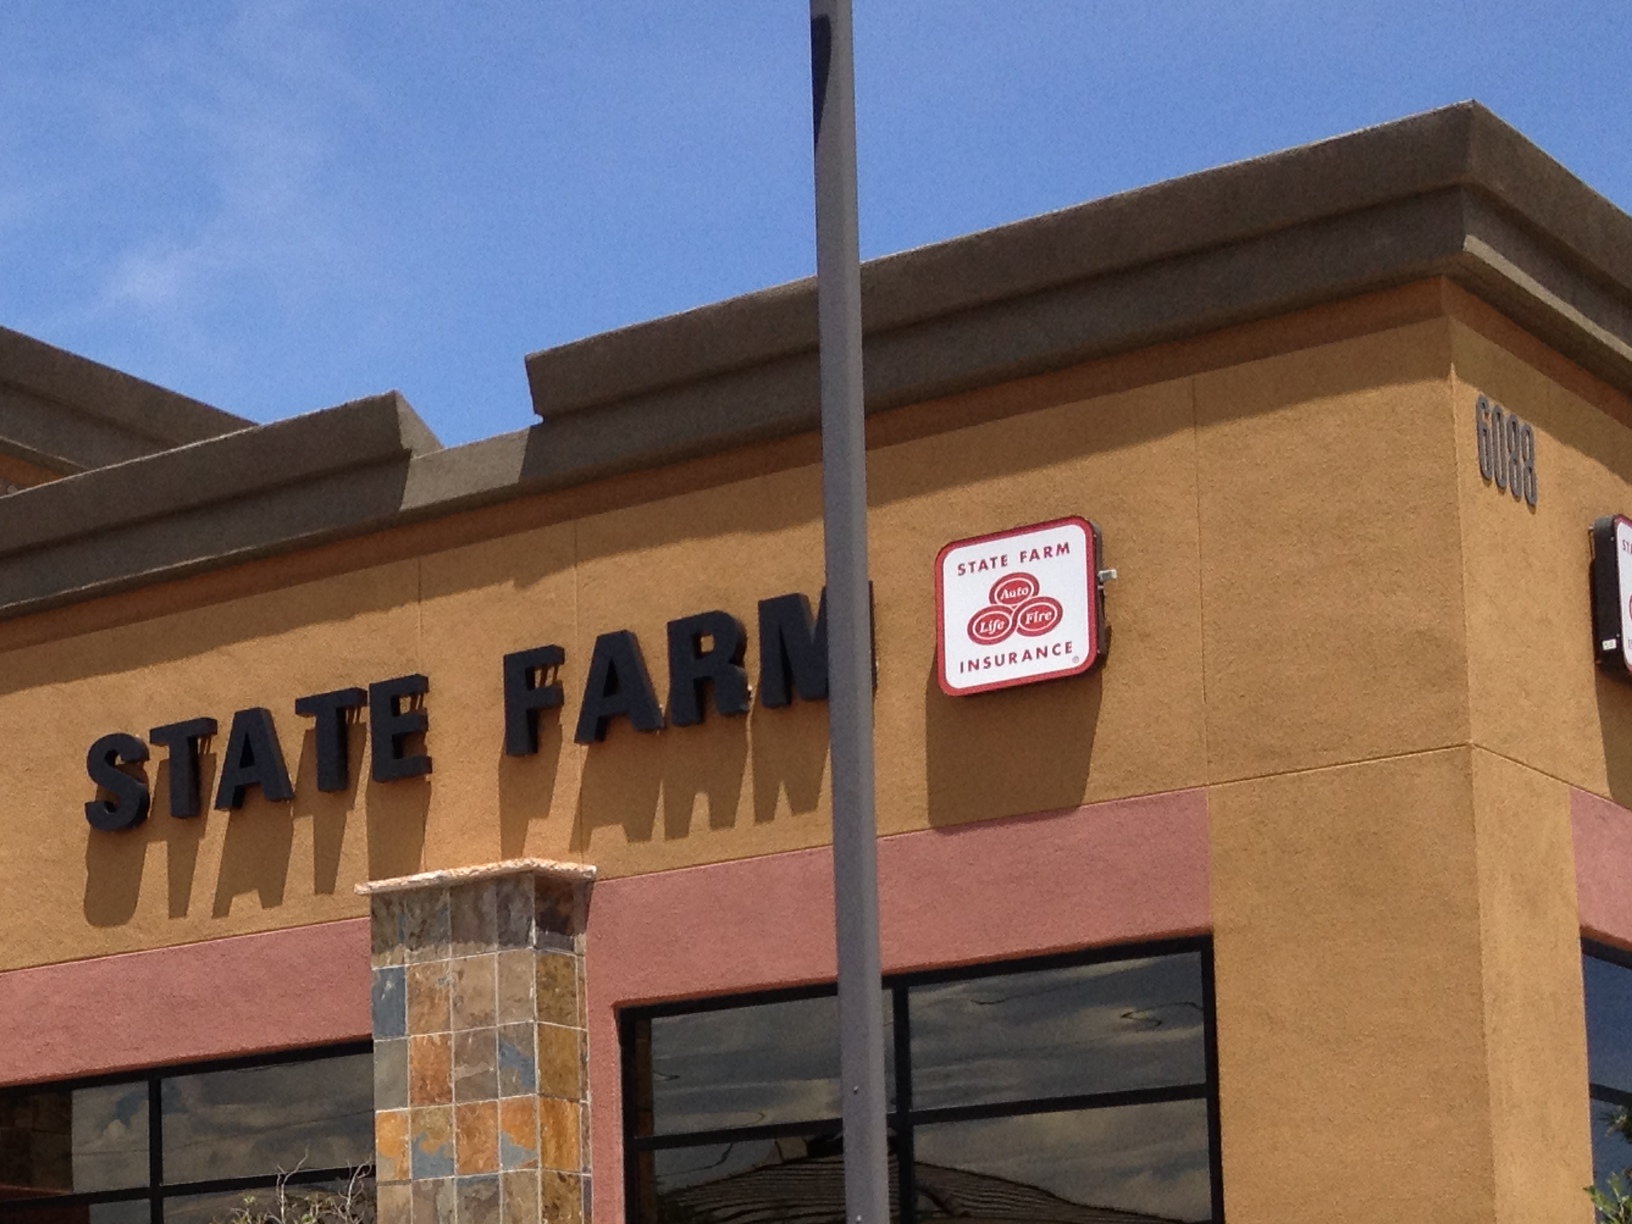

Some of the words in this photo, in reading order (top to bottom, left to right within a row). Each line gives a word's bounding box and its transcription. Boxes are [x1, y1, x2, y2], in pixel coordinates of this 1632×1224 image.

[1476, 394, 1537, 507] 6088
[957, 554, 1009, 577] STATE
[1019, 541, 1071, 564] FARM
[999, 586, 1030, 601] Auto
[979, 619, 1006, 635] Life
[1025, 611, 1052, 626] Fire
[959, 641, 1074, 674] INSURANCE
[84, 674, 433, 833] STATE
[503, 580, 877, 756] FARM
